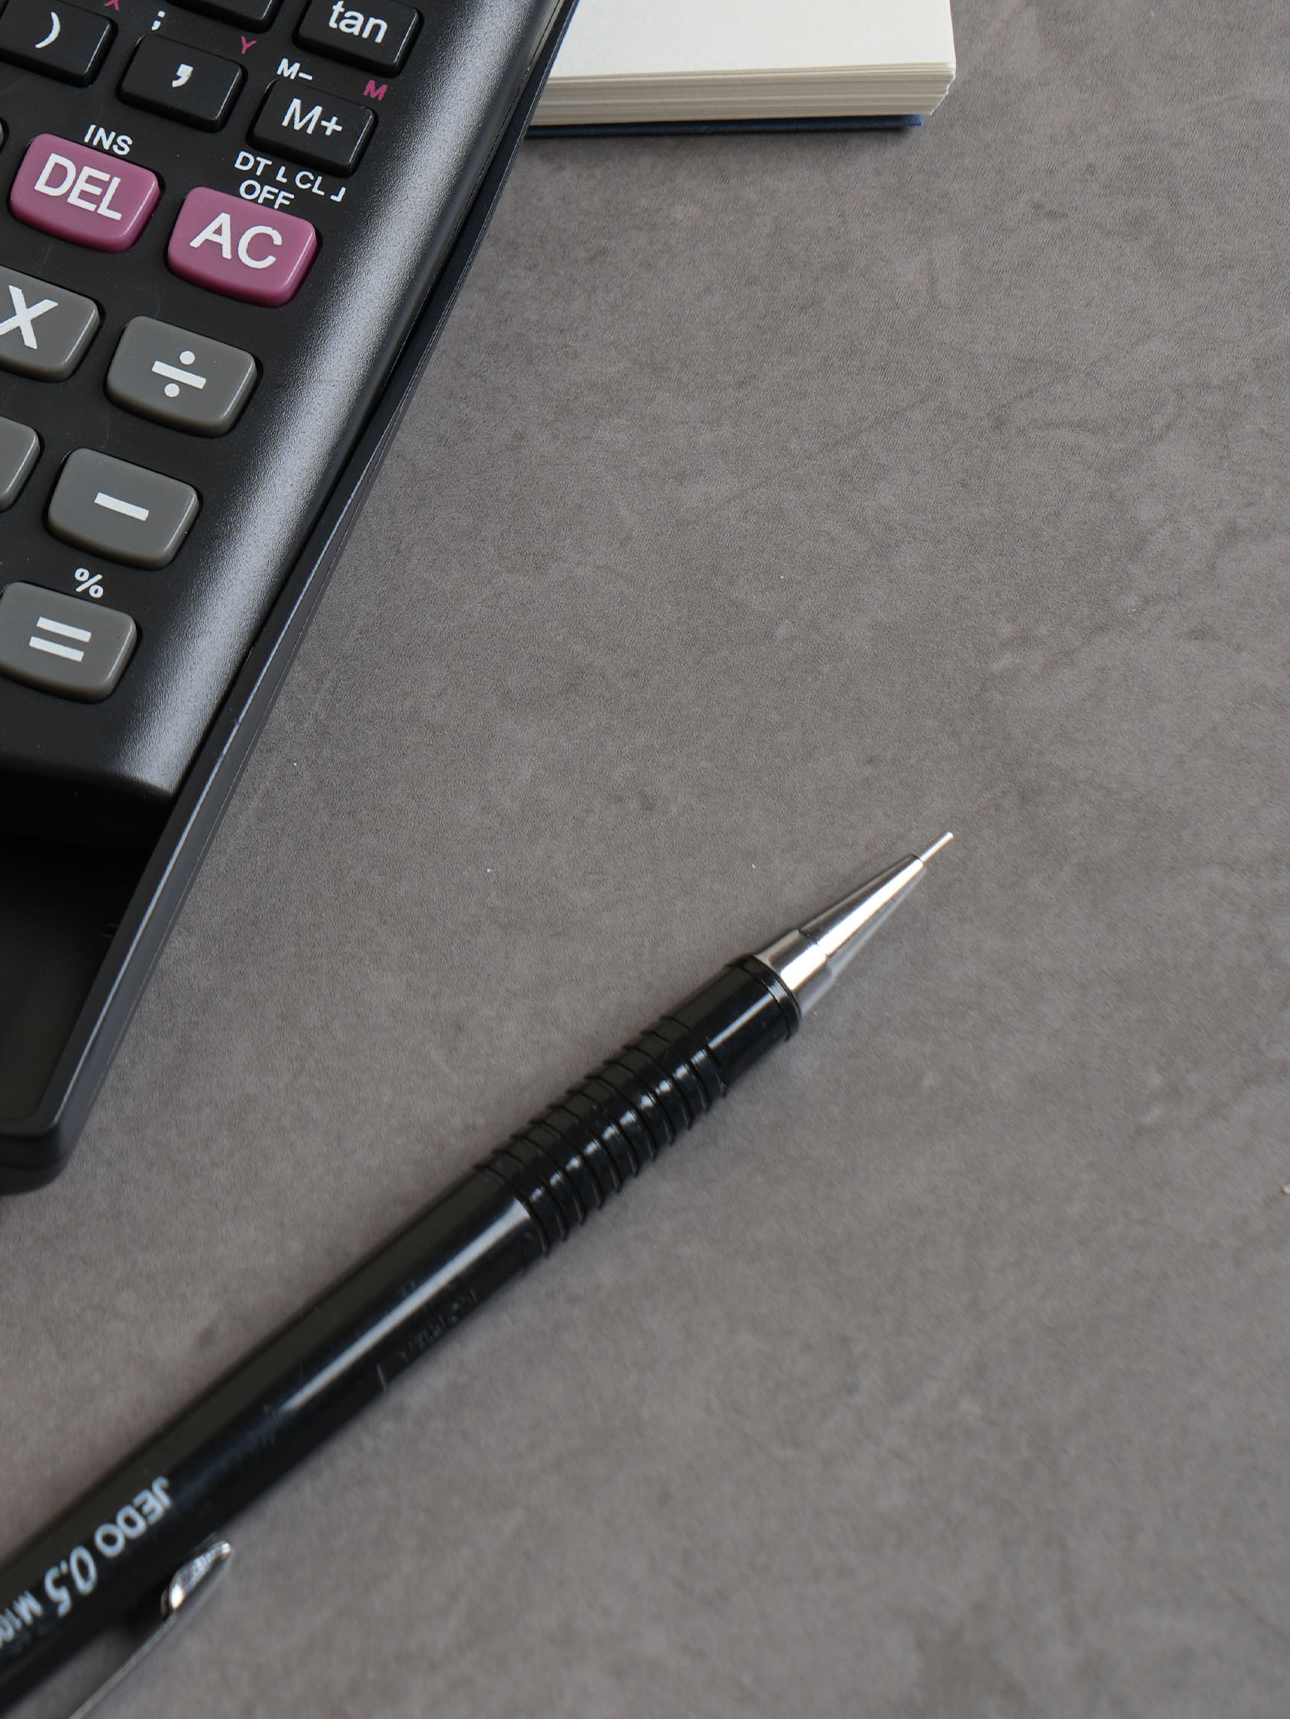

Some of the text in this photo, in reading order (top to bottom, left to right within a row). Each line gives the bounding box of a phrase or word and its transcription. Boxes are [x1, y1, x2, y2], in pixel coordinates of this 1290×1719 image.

[328, 0, 388, 44] tan
[240, 35, 257, 55] Y
[363, 78, 388, 101] M
[281, 98, 343, 136] M+
[83, 124, 133, 156] INS
[34, 153, 123, 220] DEL
[239, 180, 295, 209] OFF
[189, 212, 283, 269] AC
[74, 567, 104, 598] %
[94, 1477, 172, 1558] JEDO
[44, 1546, 97, 1618] 0.5
